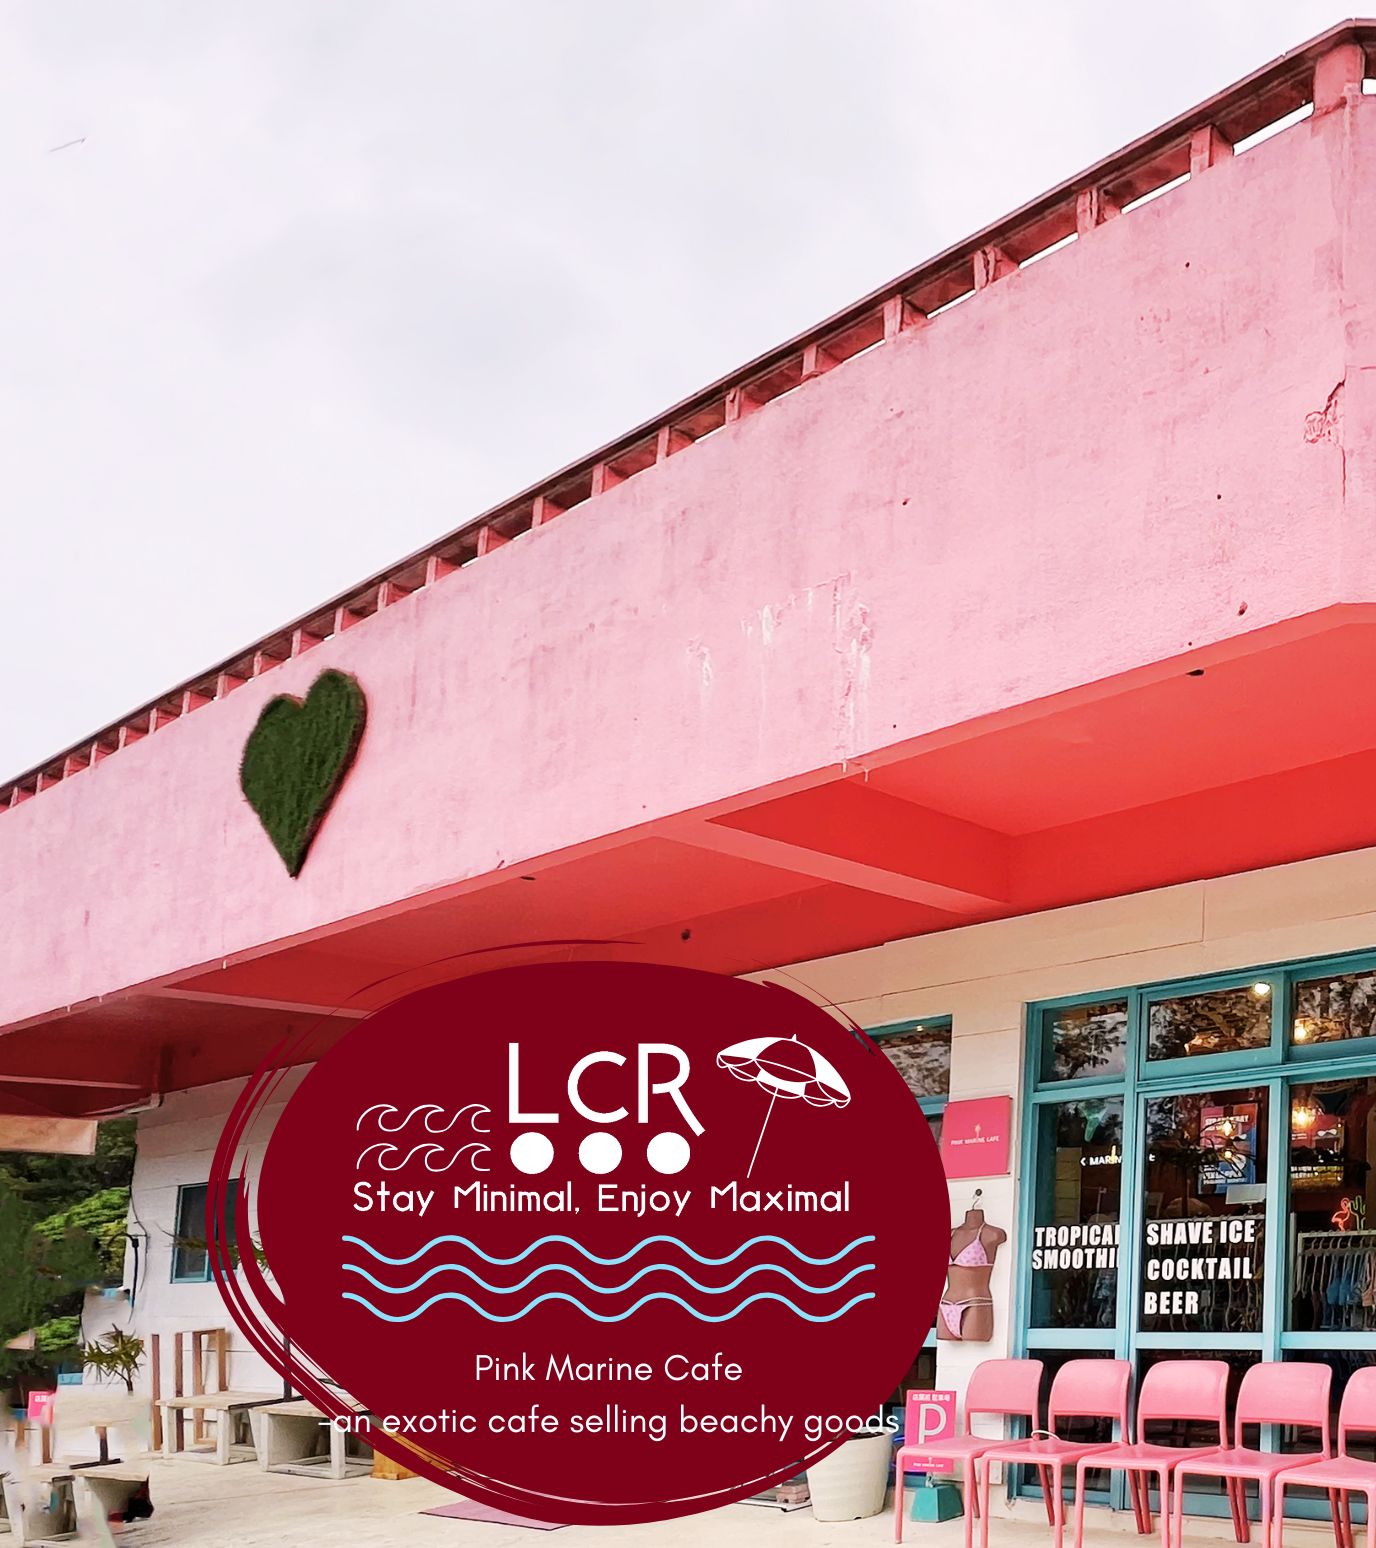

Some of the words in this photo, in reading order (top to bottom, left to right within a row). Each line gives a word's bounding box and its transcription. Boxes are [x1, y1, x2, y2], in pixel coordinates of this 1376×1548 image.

[1146, 1221, 1214, 1245] SHAVE
[1219, 1219, 1255, 1244] ICE
[1147, 1257, 1252, 1281] COCKTAIL
[1143, 1291, 1199, 1315] BEER
[919, 1403, 947, 1444] P
